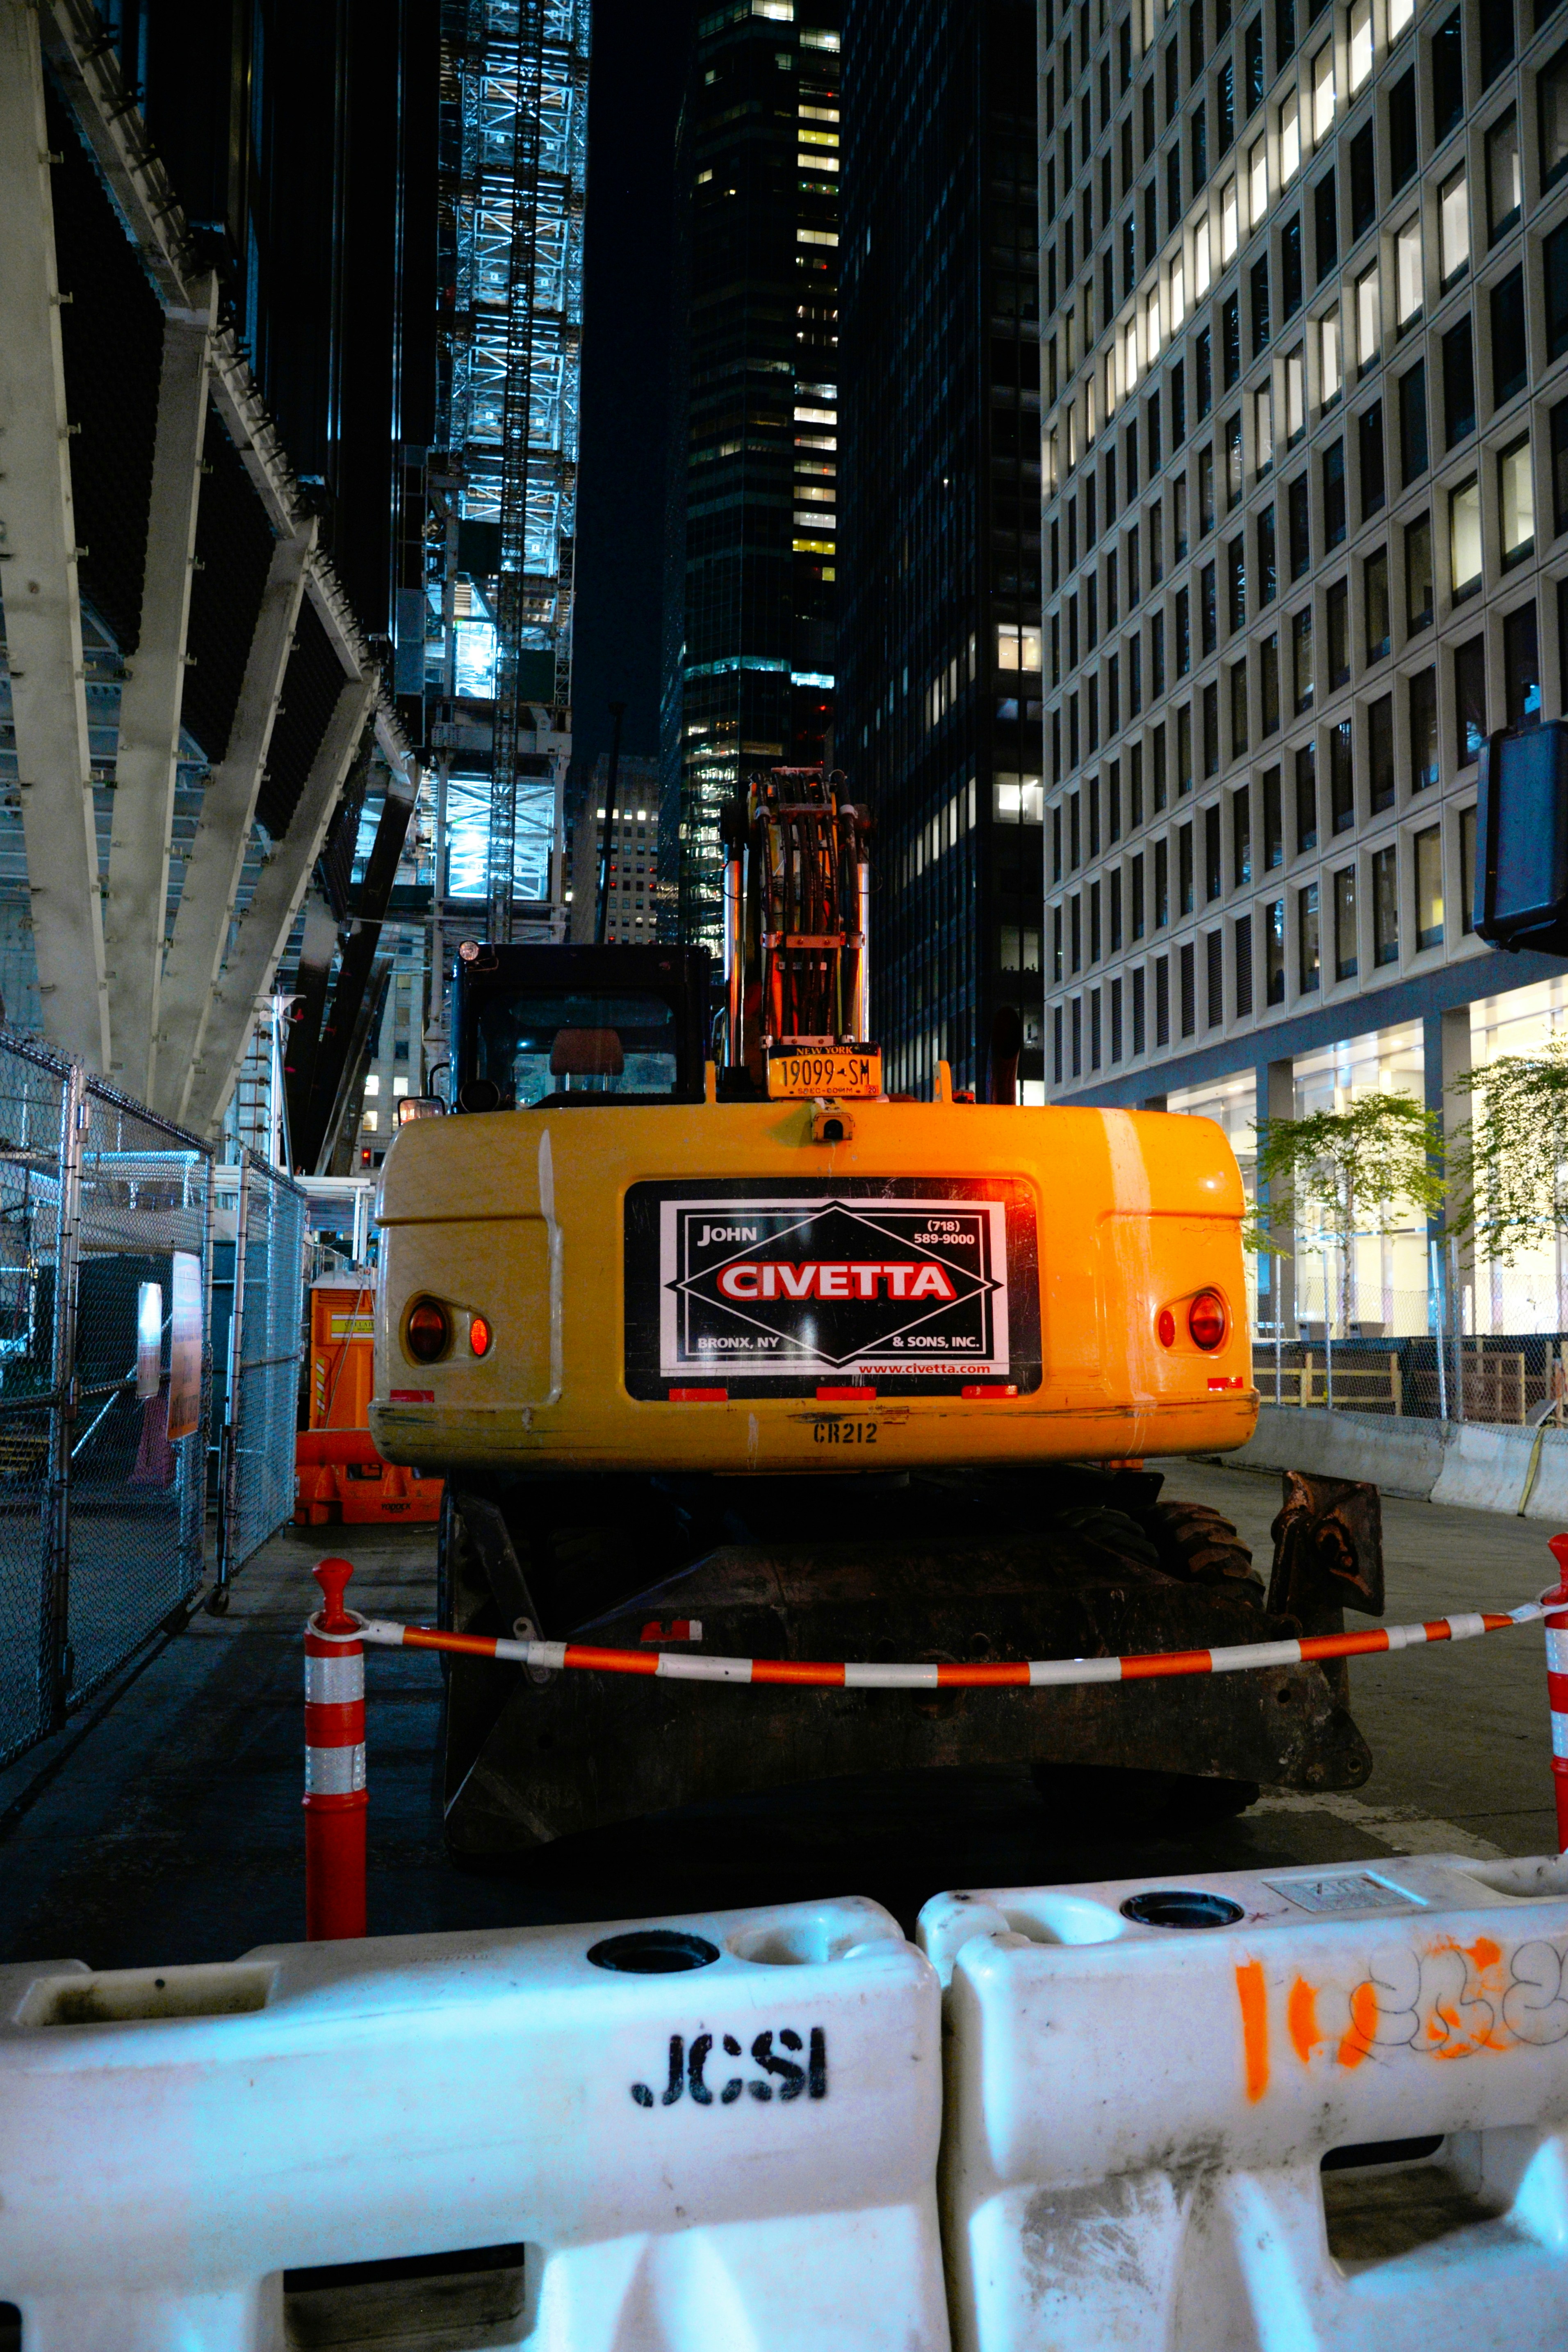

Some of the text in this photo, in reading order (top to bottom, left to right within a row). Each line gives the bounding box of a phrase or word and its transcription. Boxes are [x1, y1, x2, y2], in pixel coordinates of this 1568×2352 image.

[796, 1046, 853, 1055] NEW YORK
[927, 1220, 960, 1232] (718)
[914, 1233, 975, 1244] 589-9000
[720, 1264, 954, 1299] CIVETTA
[698, 1337, 779, 1349] BRONX, NY
[892, 1336, 980, 1349] & SONS, INC.
[859, 1363, 990, 1374] www.civetta.com
[814, 1422, 877, 1443] CR212
[381, 1502, 411, 1511] YODOCK
[630, 2026, 828, 2108] JCSI
